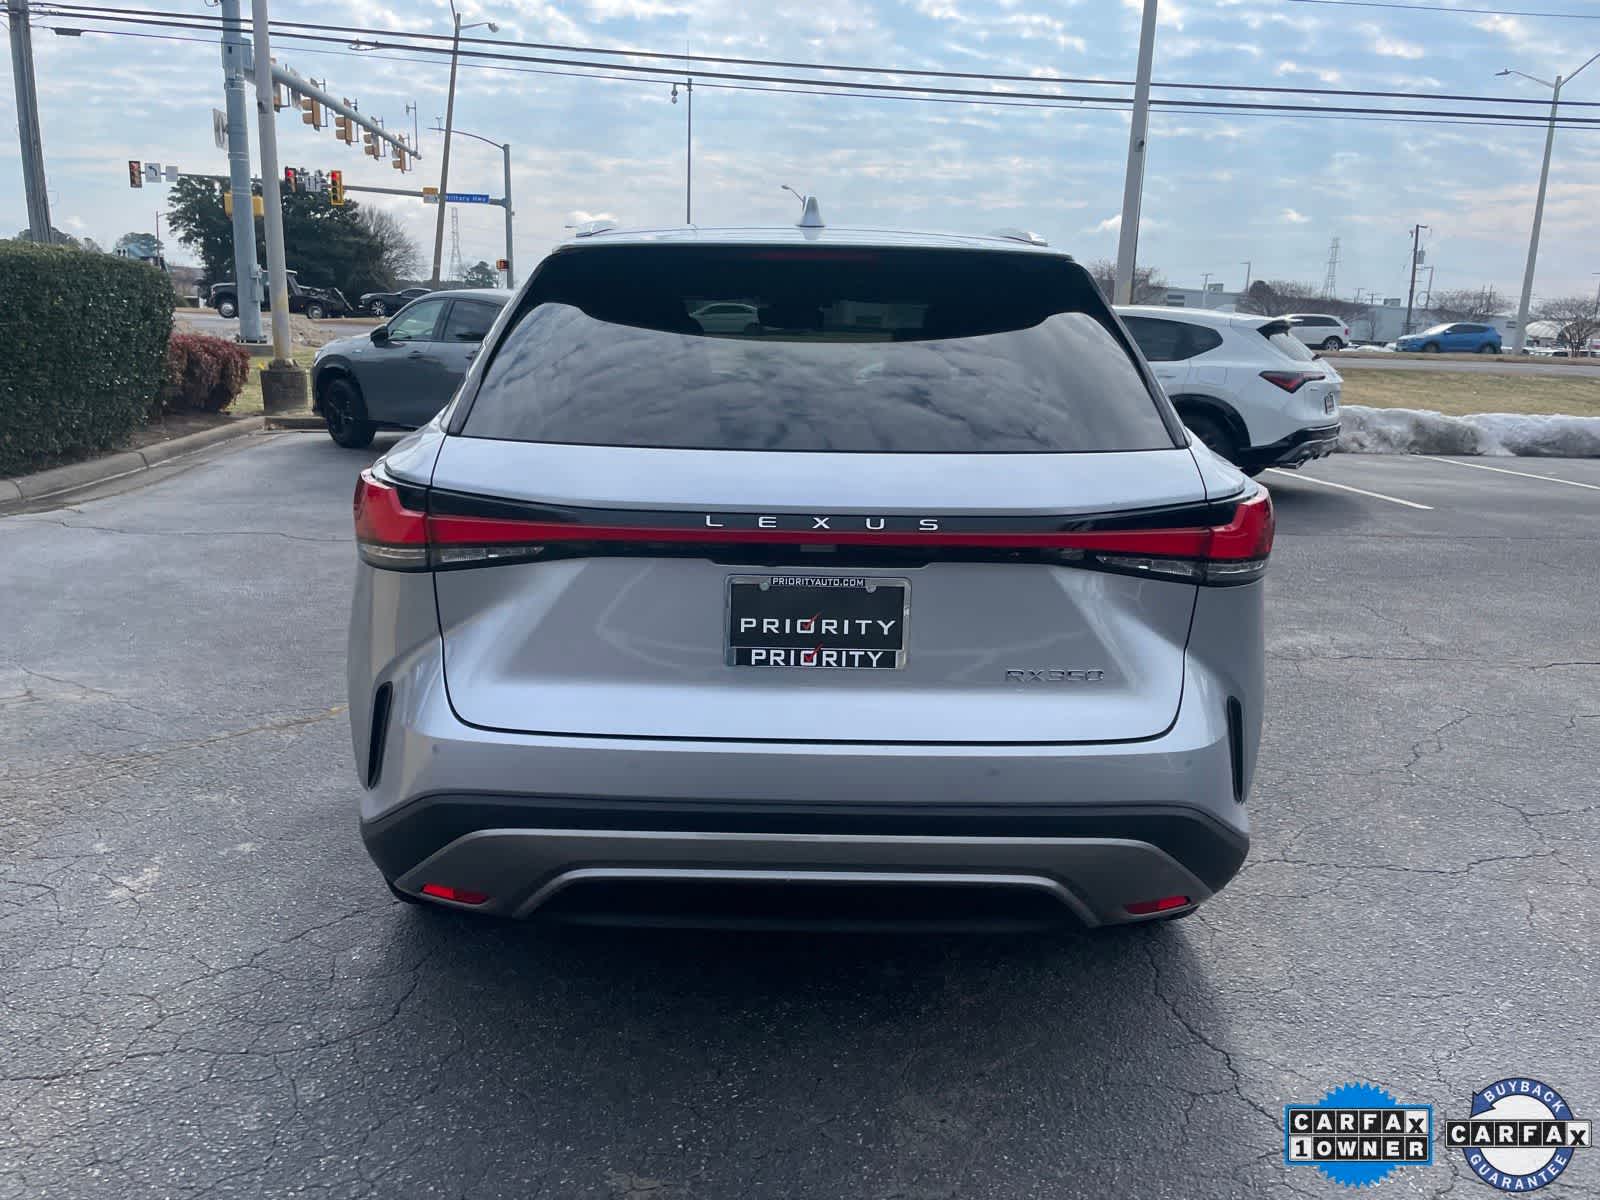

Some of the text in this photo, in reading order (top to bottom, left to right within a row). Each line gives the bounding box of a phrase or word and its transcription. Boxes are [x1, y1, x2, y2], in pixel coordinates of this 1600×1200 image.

[705, 515, 938, 531] LEXUS
[772, 577, 865, 587] PRIORITYAUTO.COM
[740, 617, 896, 635] PRIORITY
[751, 649, 883, 667] PRIORITY
